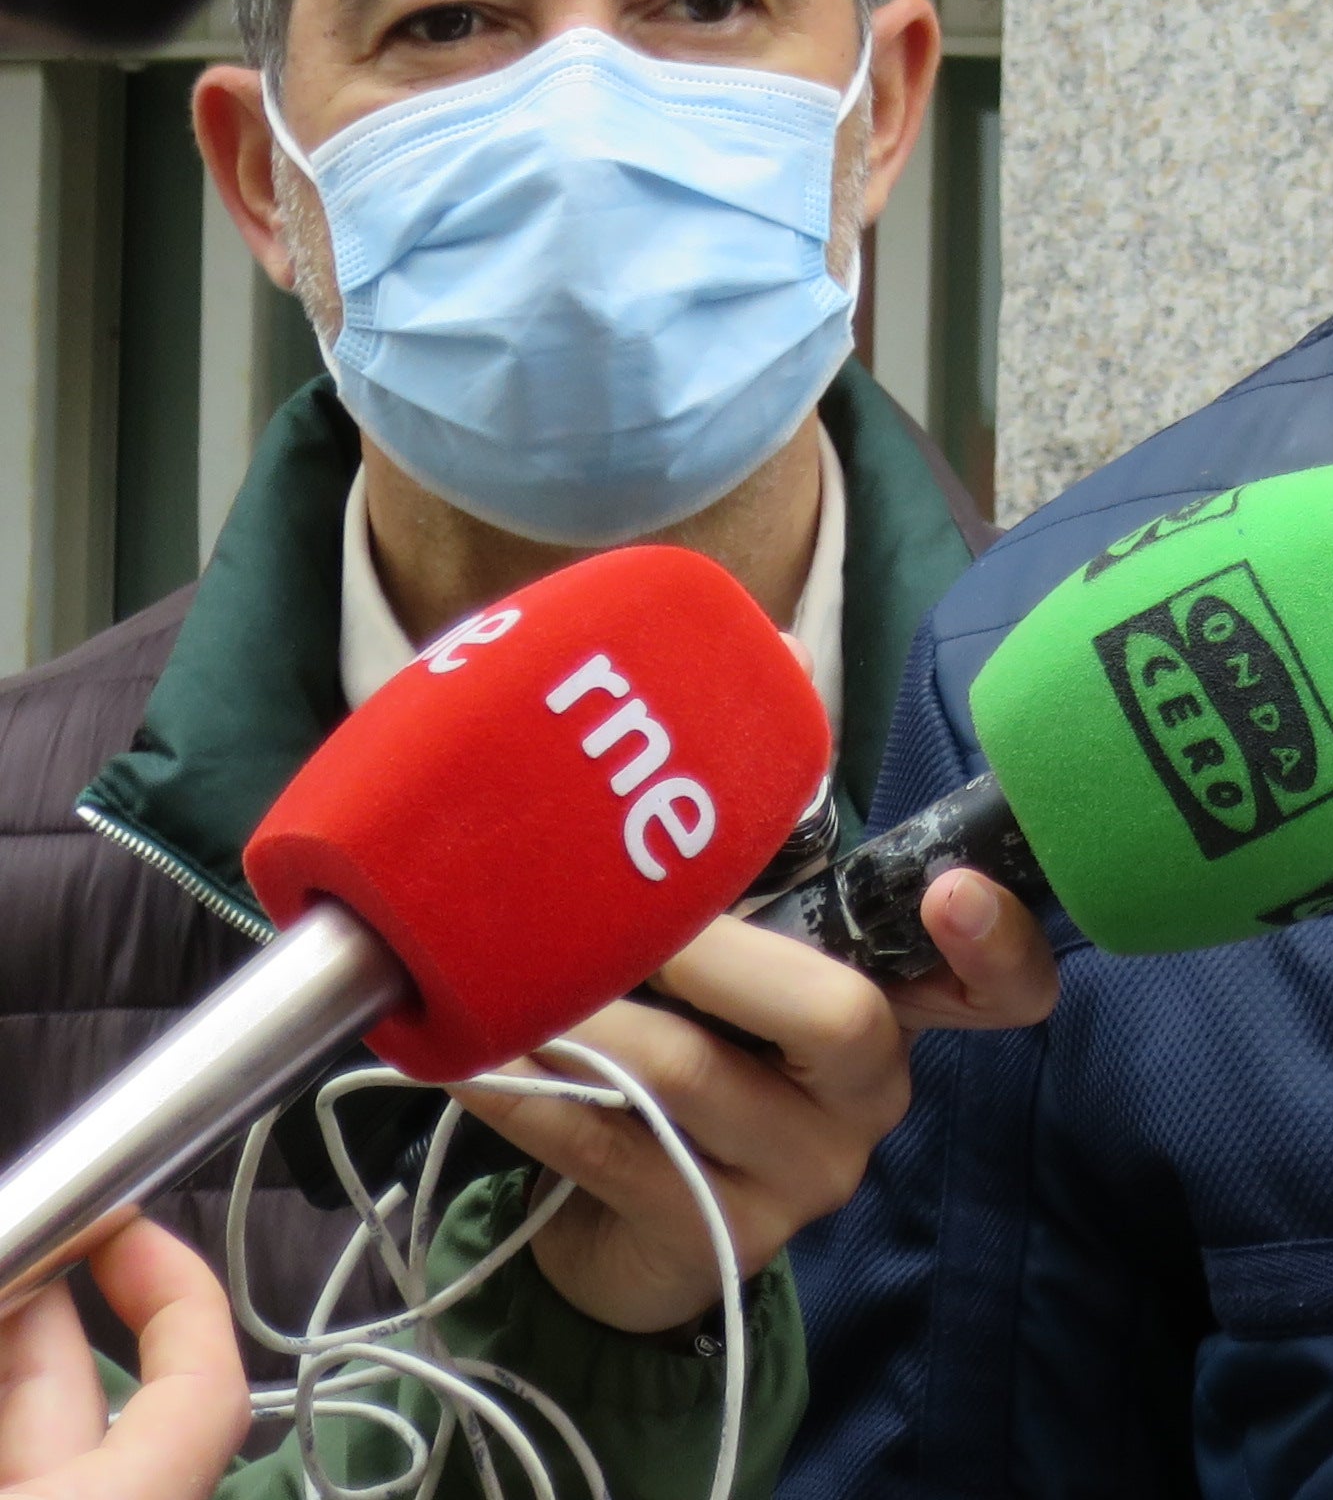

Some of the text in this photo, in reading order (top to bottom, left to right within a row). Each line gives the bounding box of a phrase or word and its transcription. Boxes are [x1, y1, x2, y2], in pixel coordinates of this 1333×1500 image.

[545, 653, 717, 882] rne
[1141, 653, 1246, 810] CERO
[1201, 610, 1302, 779] ONDA
